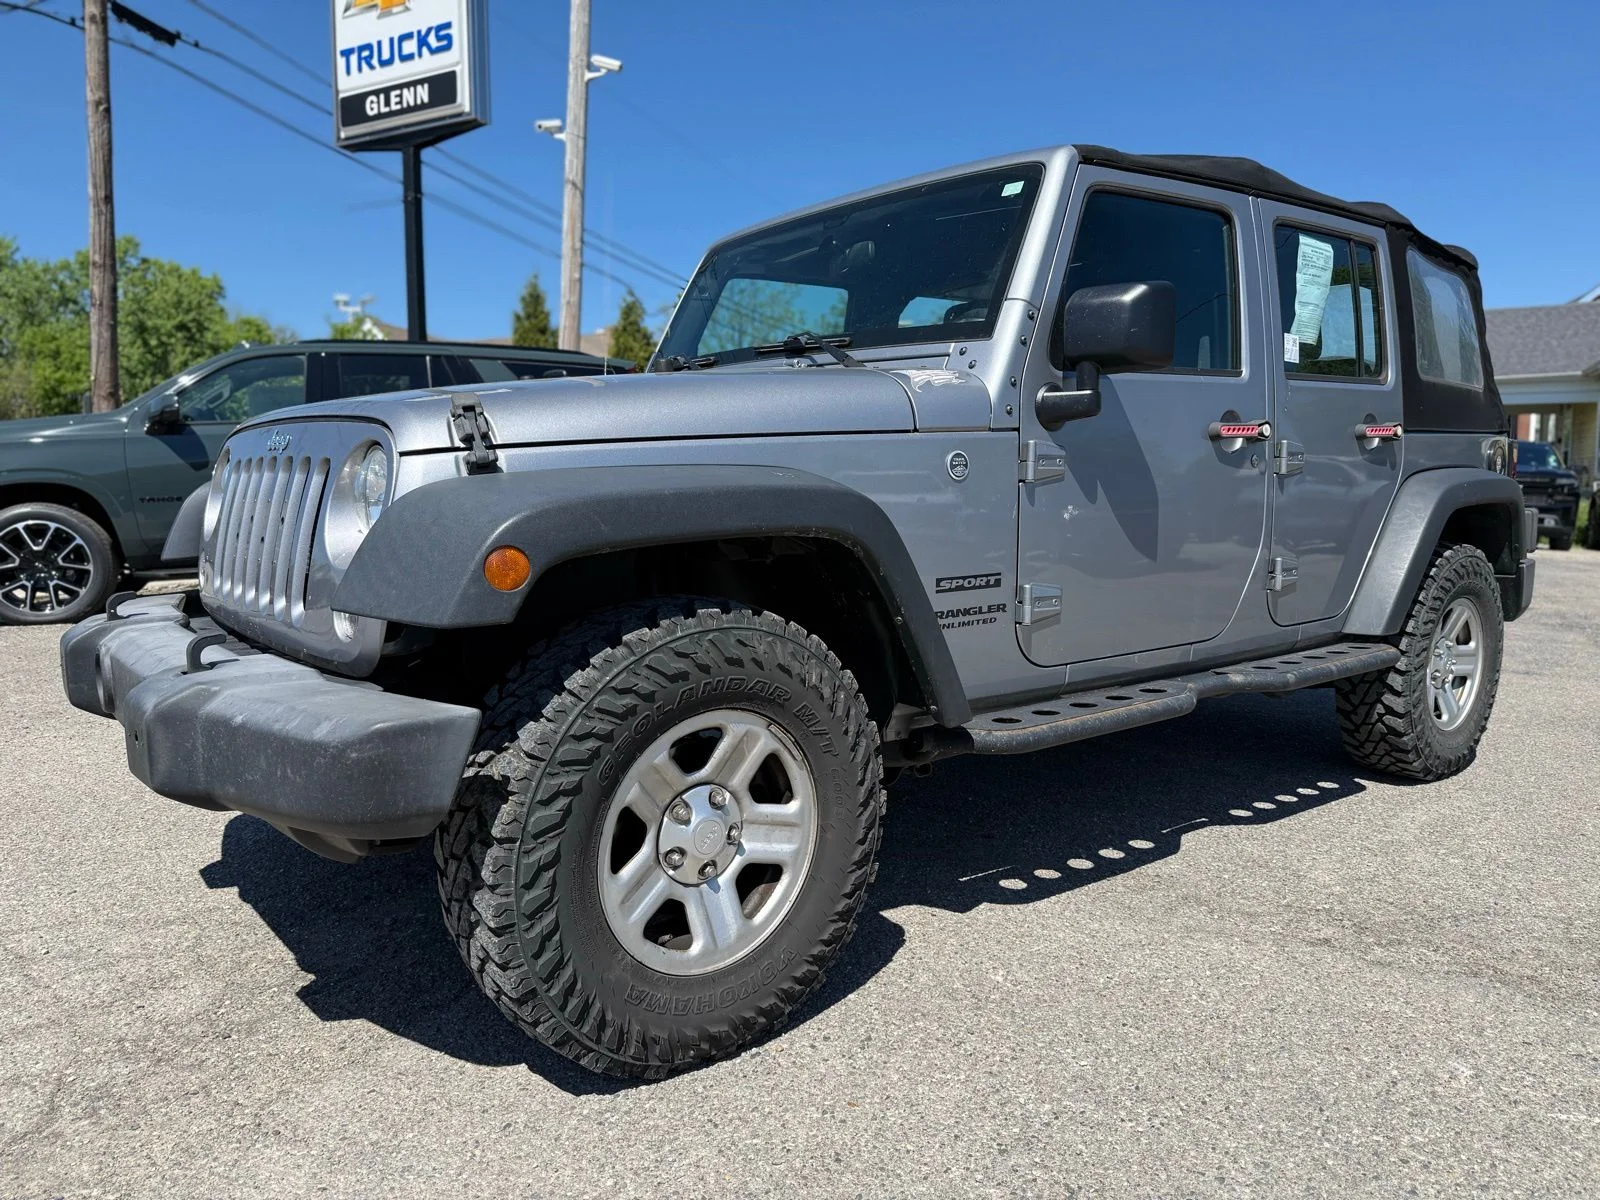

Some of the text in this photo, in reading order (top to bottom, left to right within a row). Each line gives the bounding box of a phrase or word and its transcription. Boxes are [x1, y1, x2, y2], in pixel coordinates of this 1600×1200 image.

[340, 21, 453, 76] TRUCKS
[365, 83, 429, 116] GLENN
[139, 496, 183, 504] TAHOE
[936, 575, 1001, 590] SPORT
[935, 603, 1007, 619] RANGLER
[940, 617, 997, 629] NLIMITED
[597, 675, 791, 786] GEOLANDAR
[793, 702, 839, 757] M/T
[624, 947, 798, 1016] YOKOHAMA
